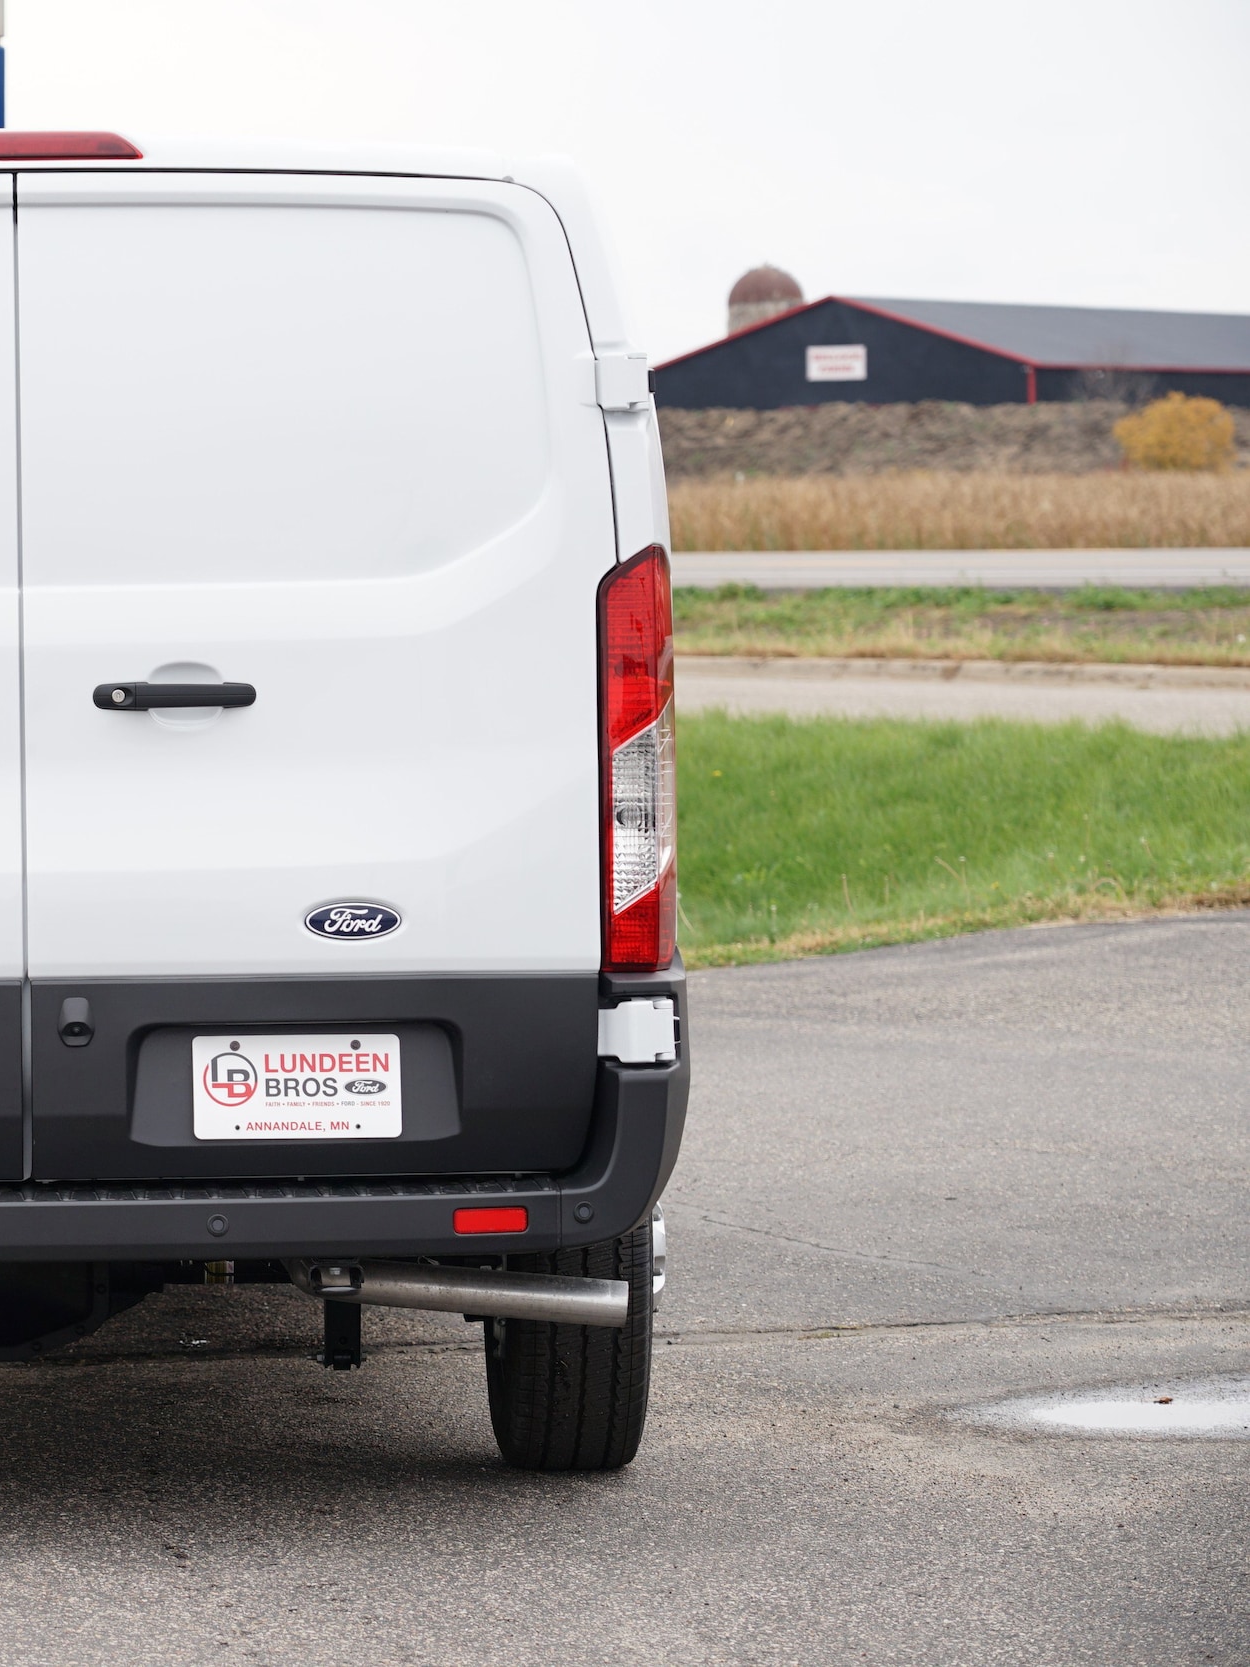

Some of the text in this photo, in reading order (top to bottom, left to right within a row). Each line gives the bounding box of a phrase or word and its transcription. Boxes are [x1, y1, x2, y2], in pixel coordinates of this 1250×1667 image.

[323, 907, 383, 933] Ford
[264, 1053, 390, 1073] LUNDEEN
[265, 1077, 338, 1097] BROS
[352, 1080, 380, 1093] Ford
[246, 1121, 350, 1133] ANNANDALE, MN
